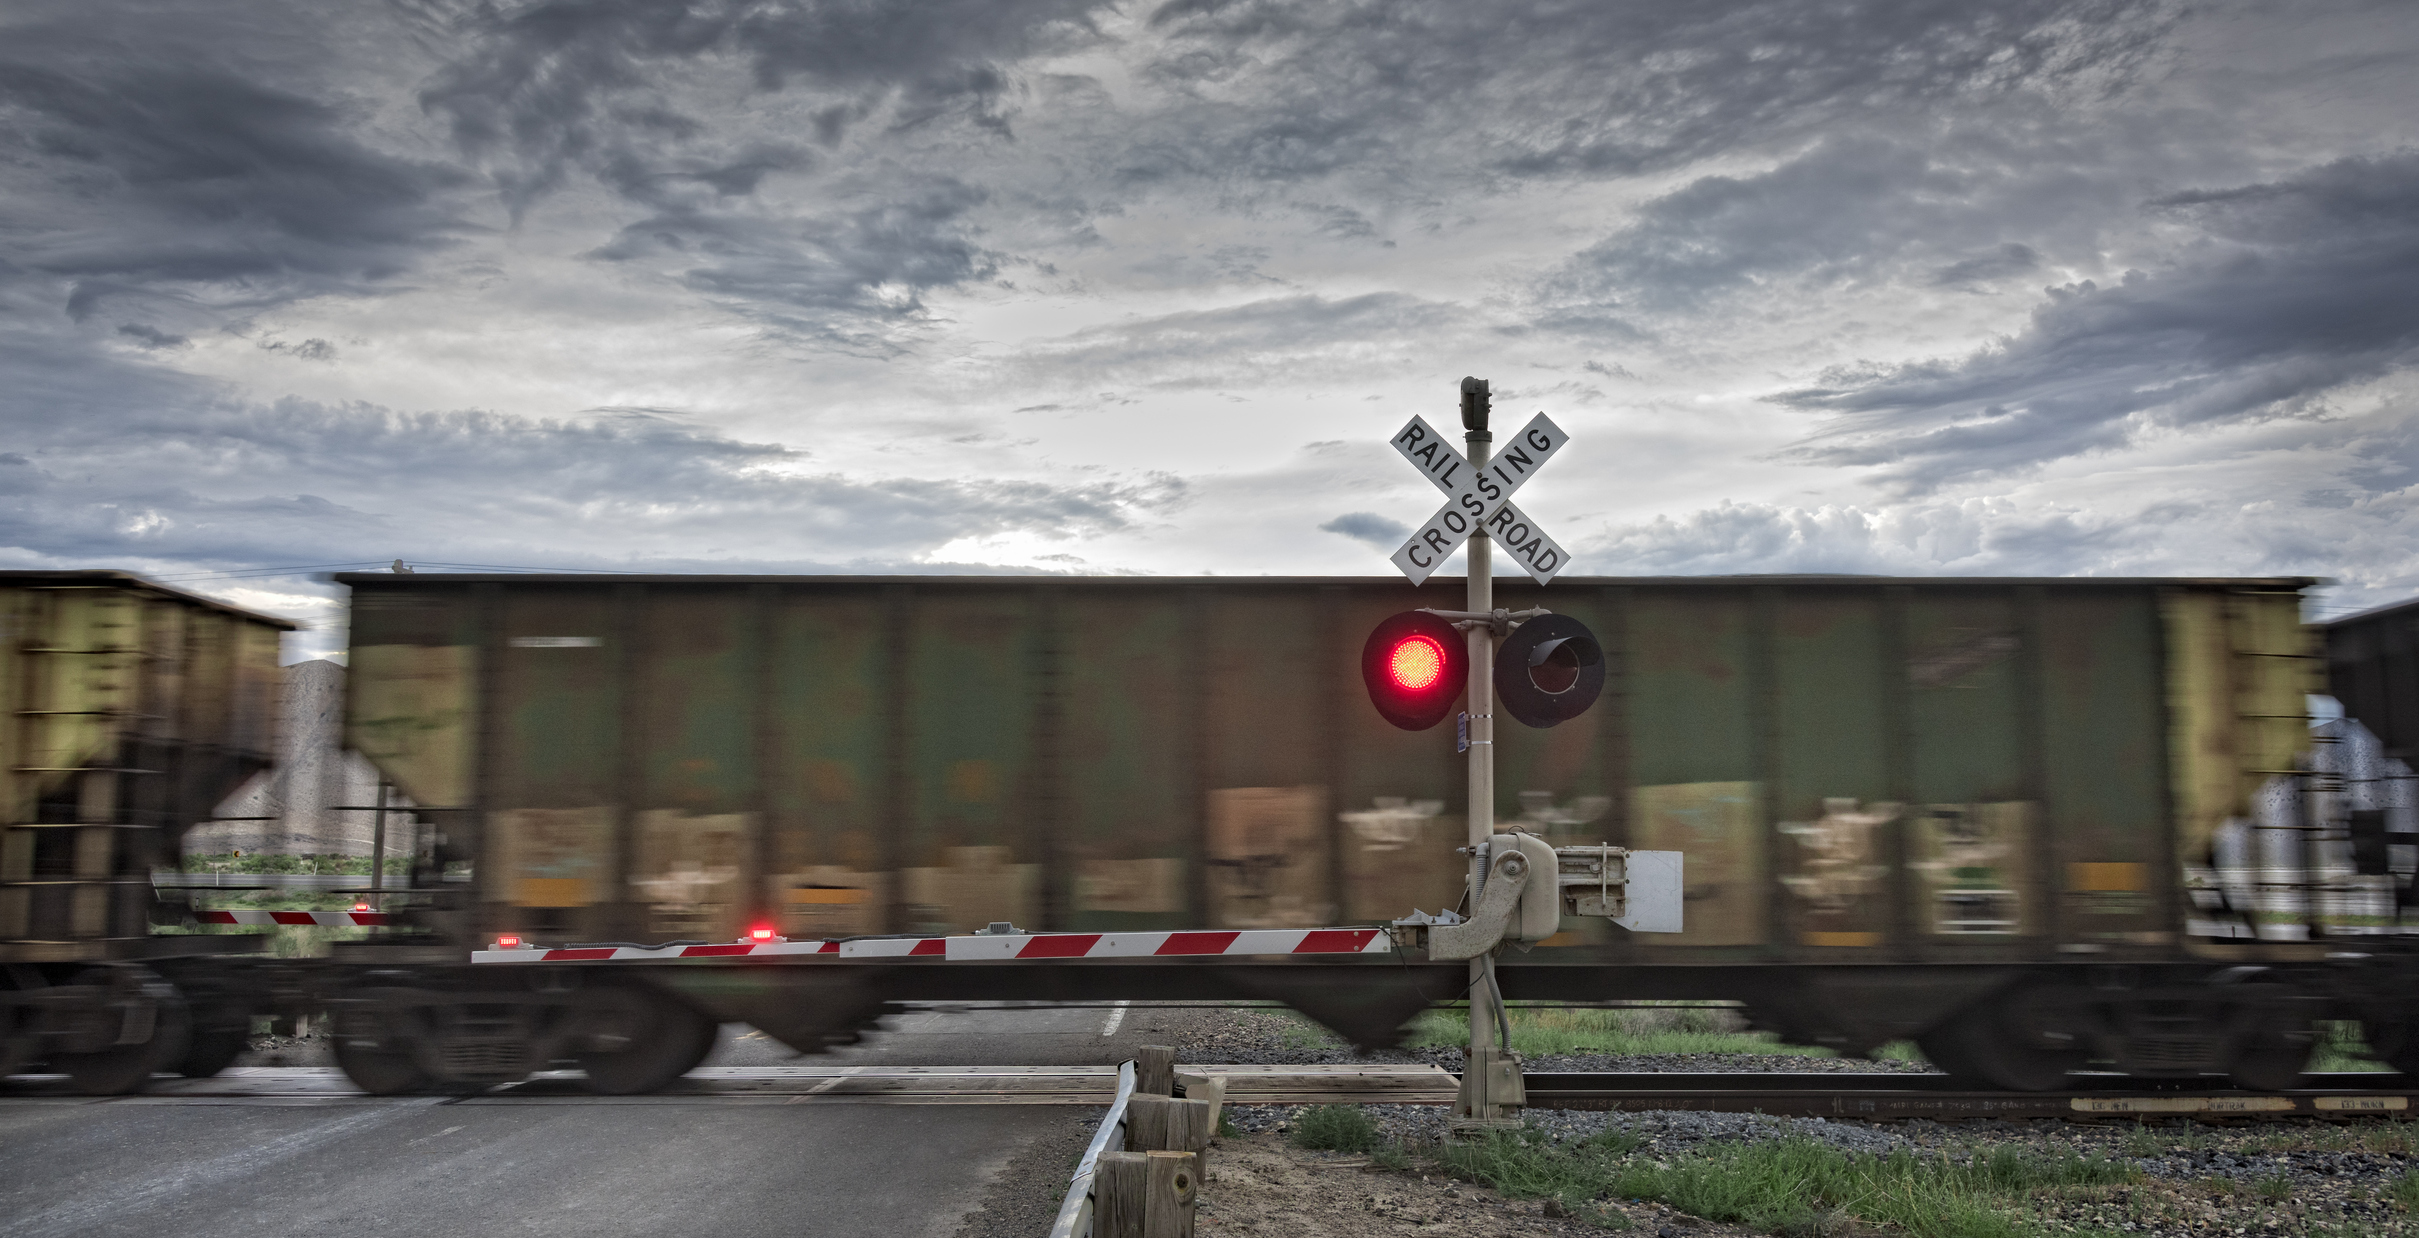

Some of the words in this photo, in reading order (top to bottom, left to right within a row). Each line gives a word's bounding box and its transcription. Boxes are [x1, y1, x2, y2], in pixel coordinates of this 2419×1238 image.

[1399, 423, 1460, 489] RAIL
[1408, 429, 1551, 568] CROSSING
[1488, 506, 1558, 573] ROAD
